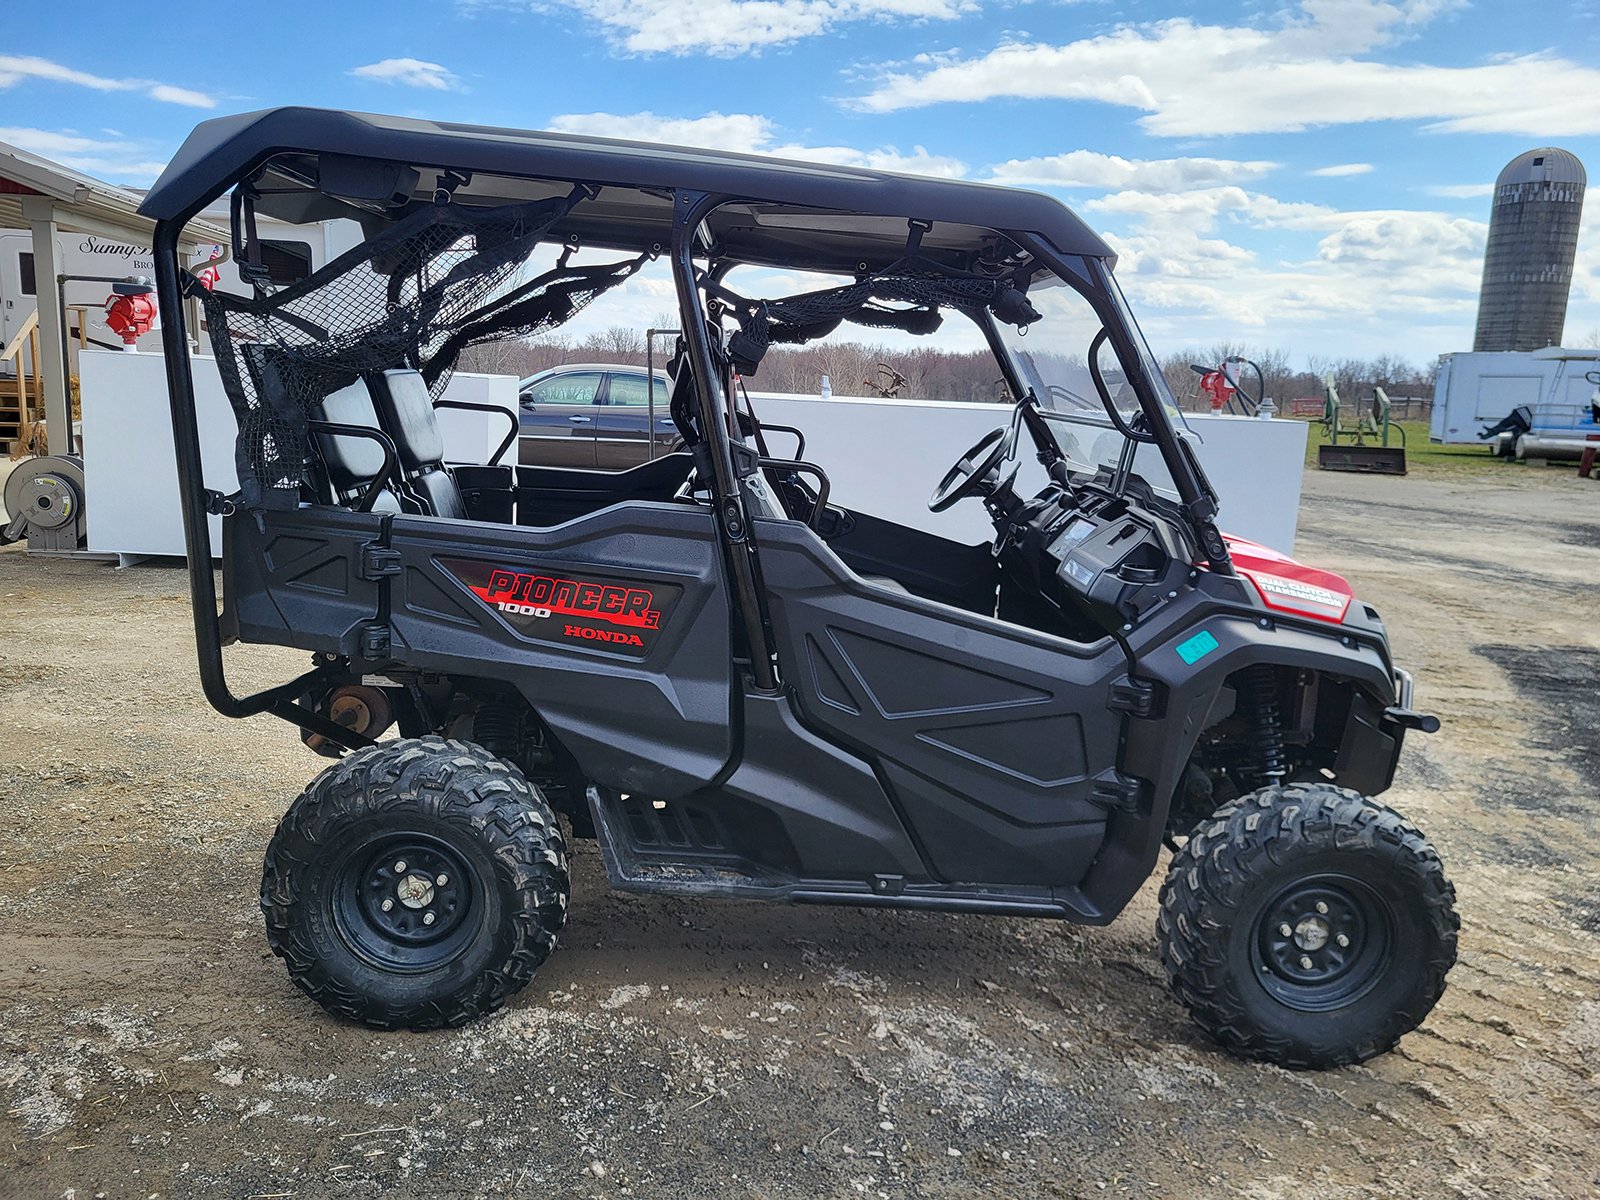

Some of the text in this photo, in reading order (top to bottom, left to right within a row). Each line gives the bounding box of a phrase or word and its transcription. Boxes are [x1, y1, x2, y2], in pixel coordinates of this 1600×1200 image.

[487, 569, 653, 617] PIONEER
[1256, 575, 1332, 598] DUAL CLUTCH
[1259, 583, 1343, 608] TRANSMISSION
[497, 601, 552, 619] 1000
[563, 624, 645, 647] HONDA
